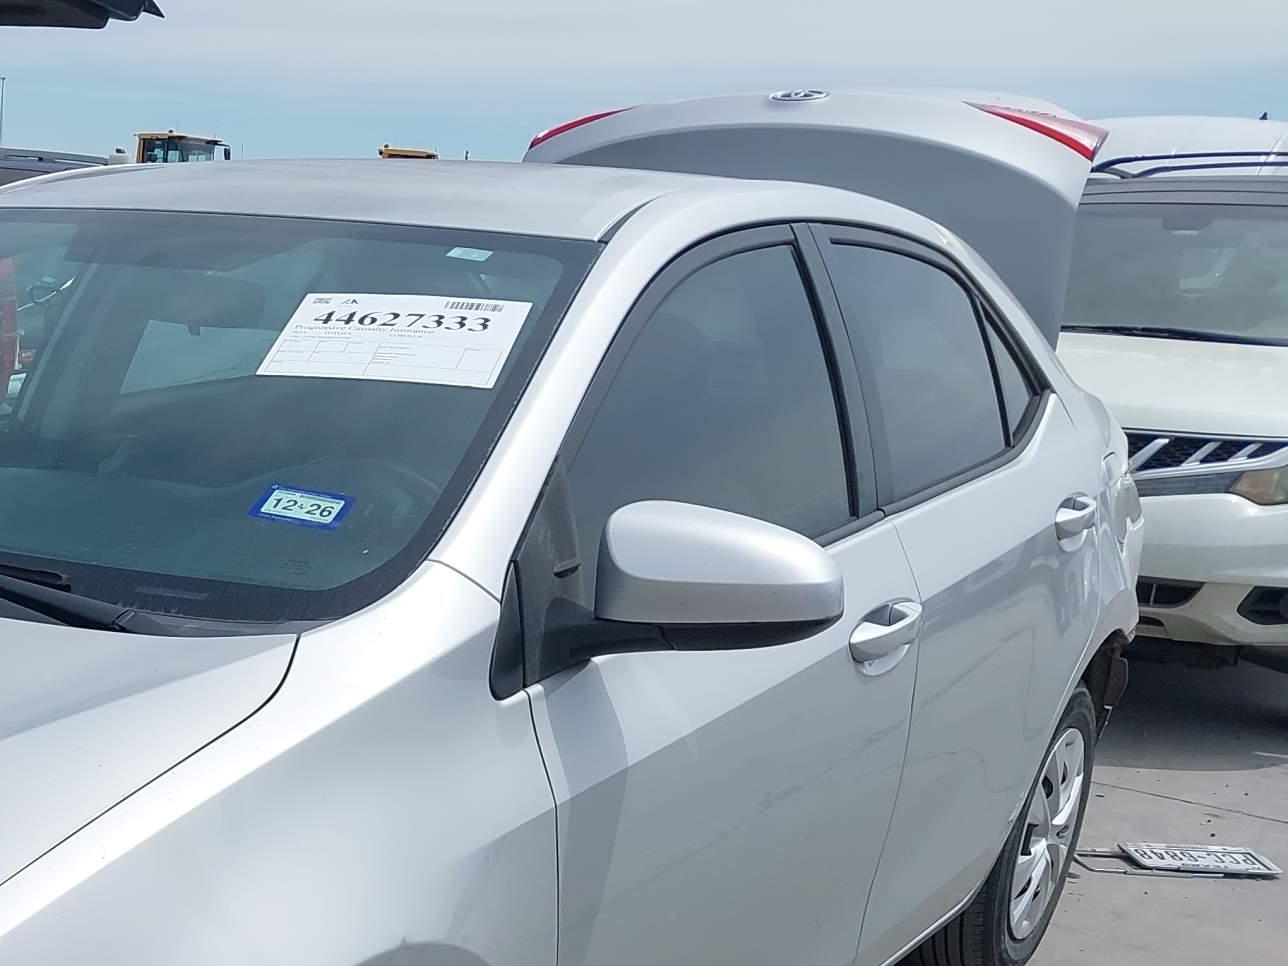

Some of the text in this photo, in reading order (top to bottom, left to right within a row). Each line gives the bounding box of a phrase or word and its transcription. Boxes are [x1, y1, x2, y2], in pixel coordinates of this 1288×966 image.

[313, 310, 491, 332] 44627333
[273, 497, 298, 511] 12
[304, 503, 335, 518] 26
